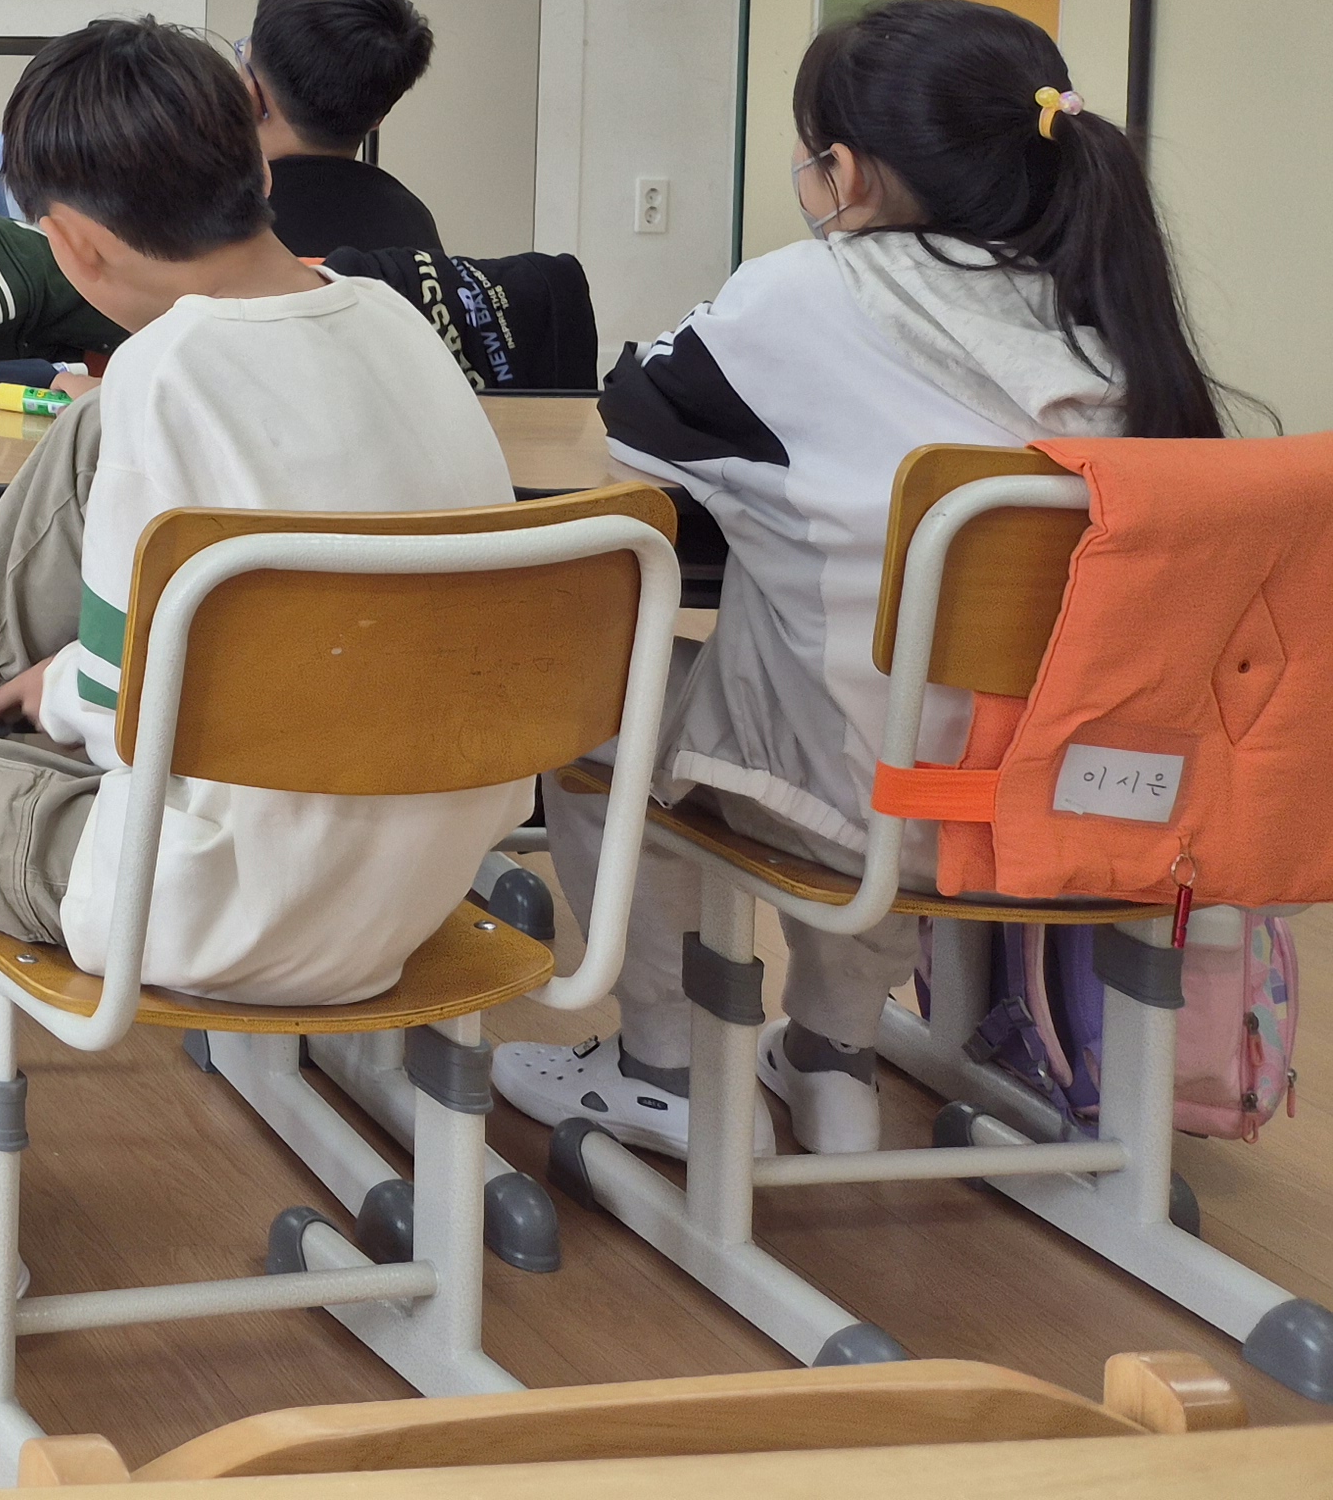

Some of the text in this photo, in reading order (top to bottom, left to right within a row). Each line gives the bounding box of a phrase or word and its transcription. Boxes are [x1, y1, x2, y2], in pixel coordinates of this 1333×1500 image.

[487, 287, 501, 310] THE
[495, 310, 516, 350] INSPIRE
[480, 331, 514, 382] NEW
